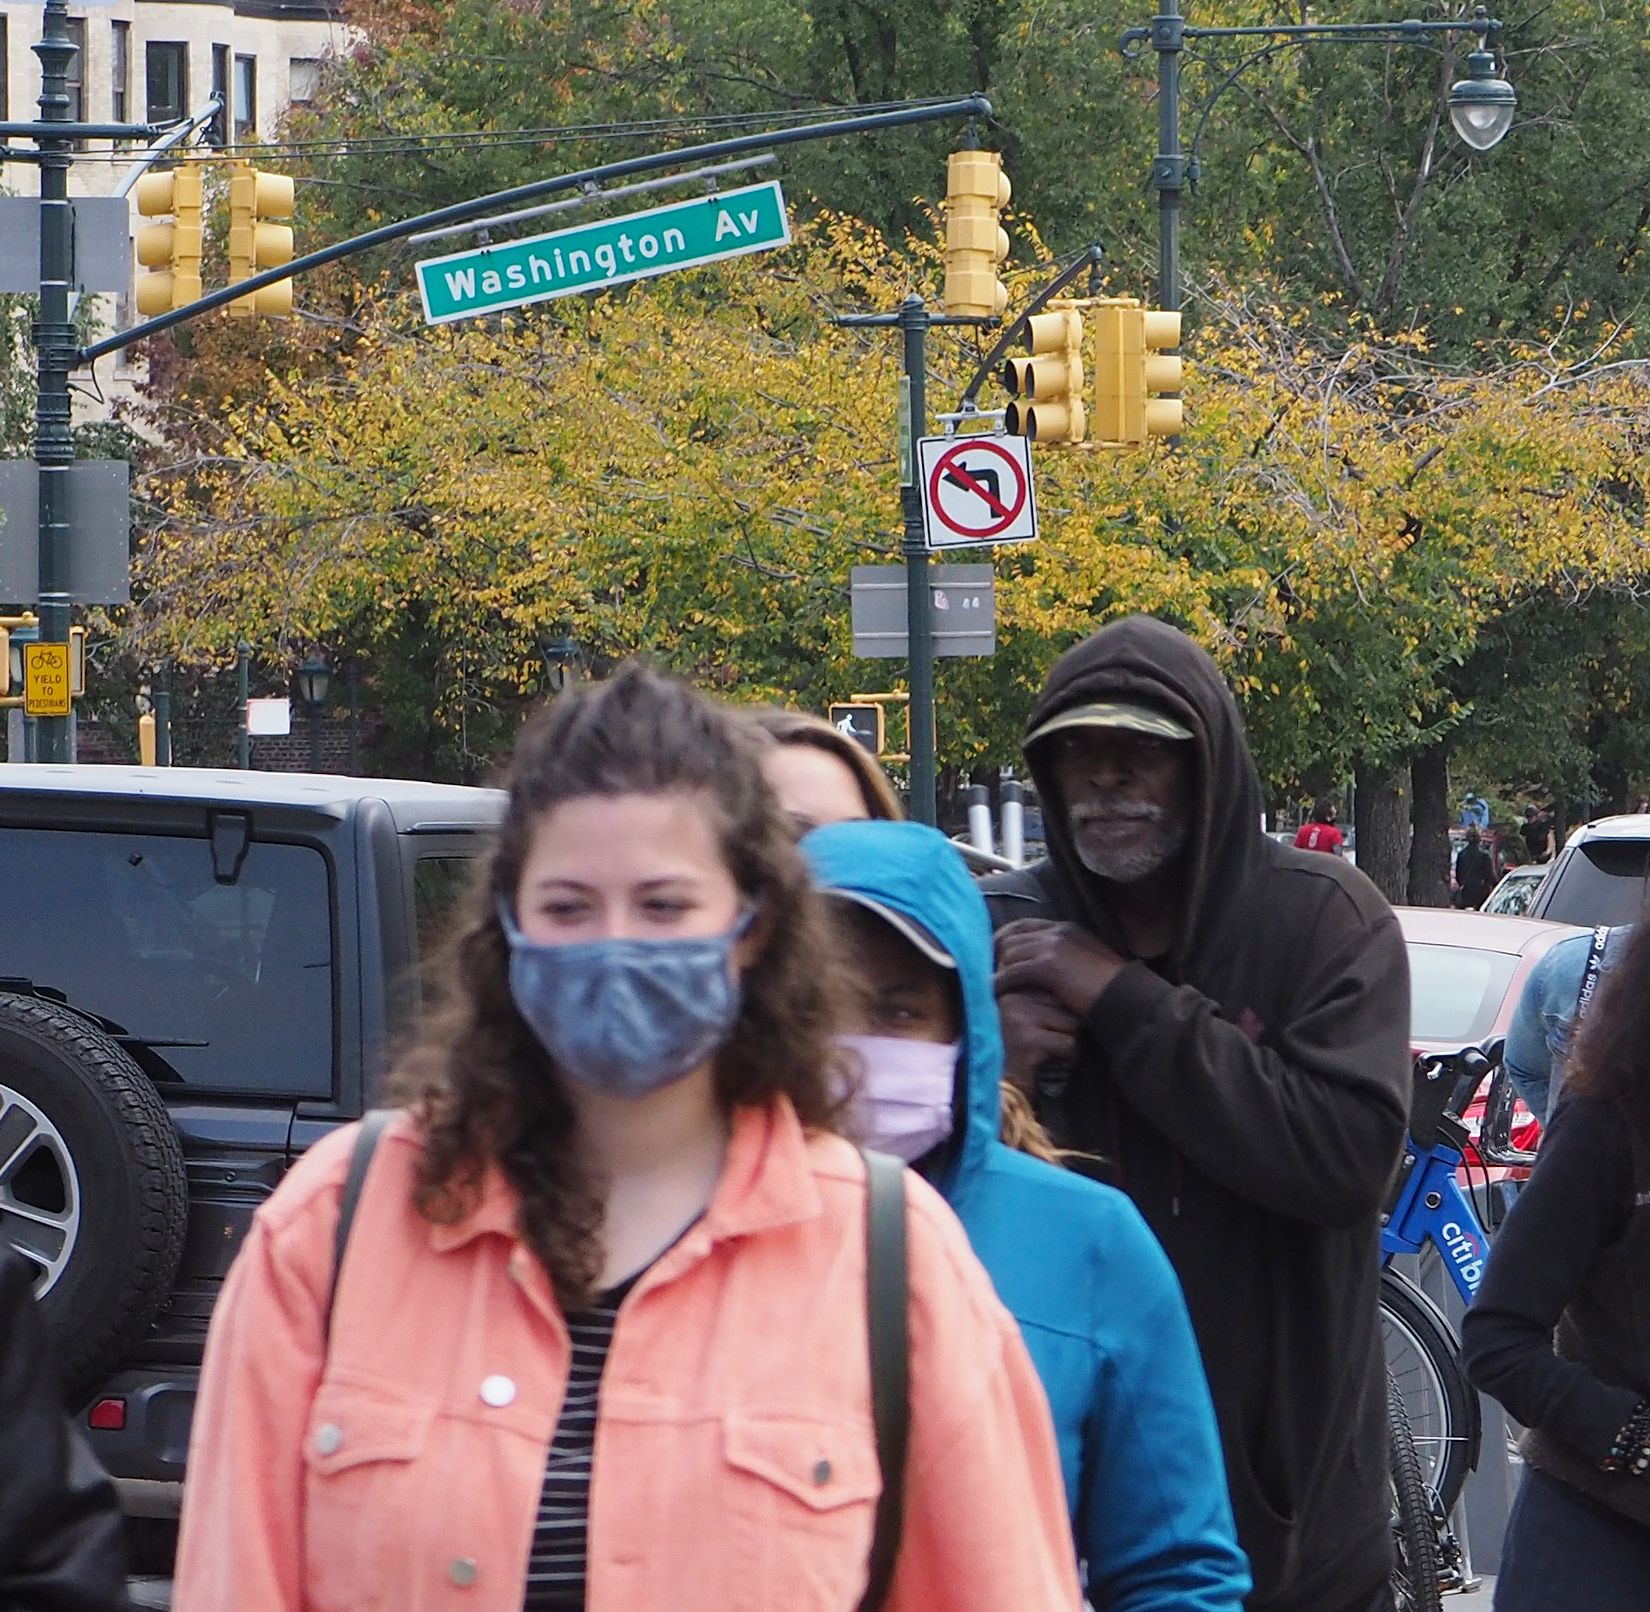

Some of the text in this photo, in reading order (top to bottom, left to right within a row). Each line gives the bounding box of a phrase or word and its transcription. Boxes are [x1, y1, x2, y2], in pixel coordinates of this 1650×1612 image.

[444, 209, 758, 302] Washington Av
[34, 674, 61, 683] YIELD
[42, 687, 53, 695] TO
